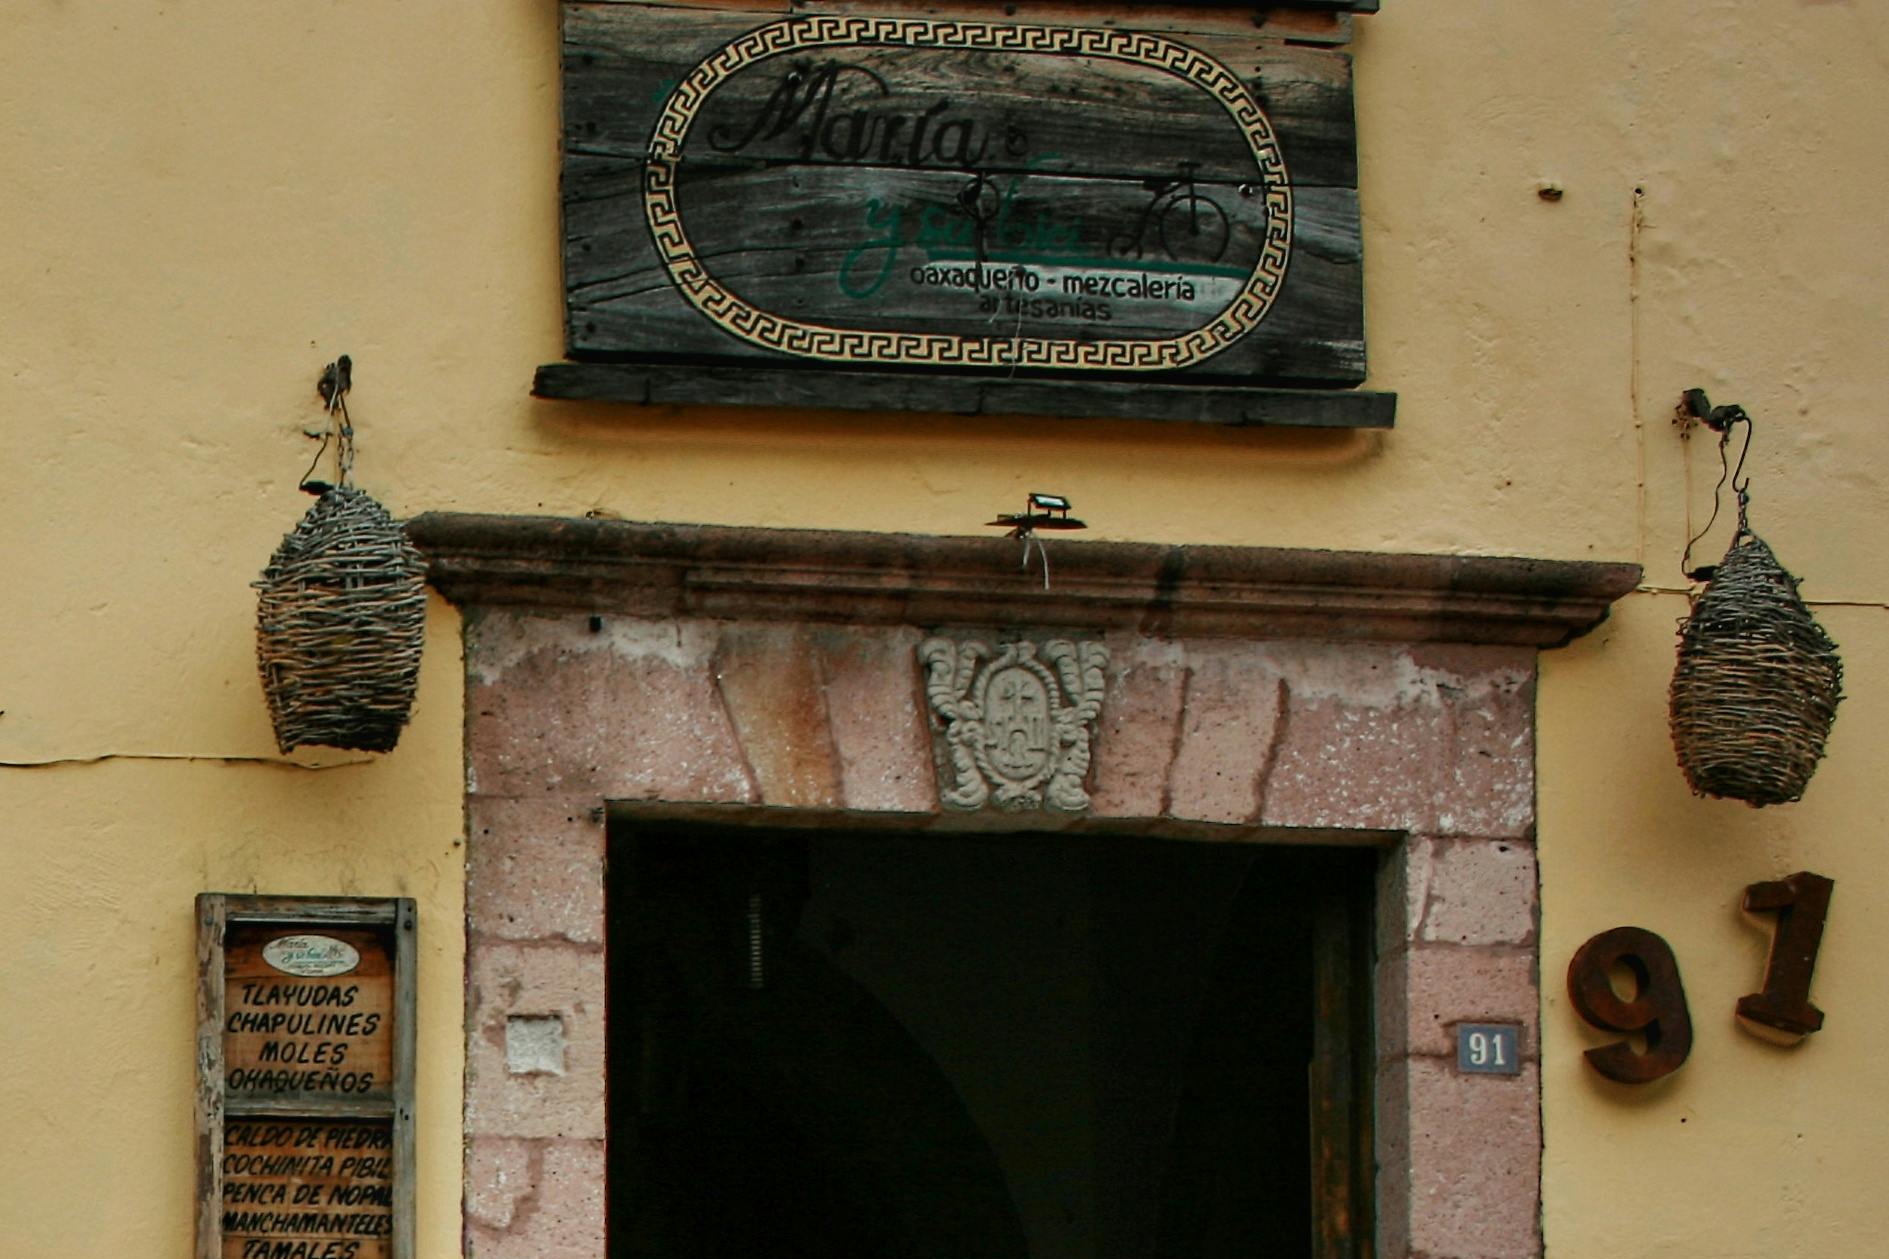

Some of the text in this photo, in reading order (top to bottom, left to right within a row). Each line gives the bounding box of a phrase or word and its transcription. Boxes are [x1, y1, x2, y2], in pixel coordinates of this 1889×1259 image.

[707, 57, 989, 165] María
[839, 196, 905, 299] y
[1062, 272, 1196, 302] mezcalería
[978, 293, 1113, 322] artesanías
[1566, 870, 1836, 1086] 91
[242, 983, 360, 1008] TLAYUDAS
[226, 1011, 382, 1036] CHAPULINES
[258, 1040, 349, 1065] MOLES
[1468, 1032, 1507, 1067] 91
[224, 1125, 291, 1148] CALDO
[295, 1126, 322, 1149] DE
[223, 1154, 393, 1180] COCHINITA PIBIL
[223, 1183, 288, 1205] PENCA
[292, 1183, 324, 1206] DE
[222, 1210, 394, 1236] MANCHAMANTELES
